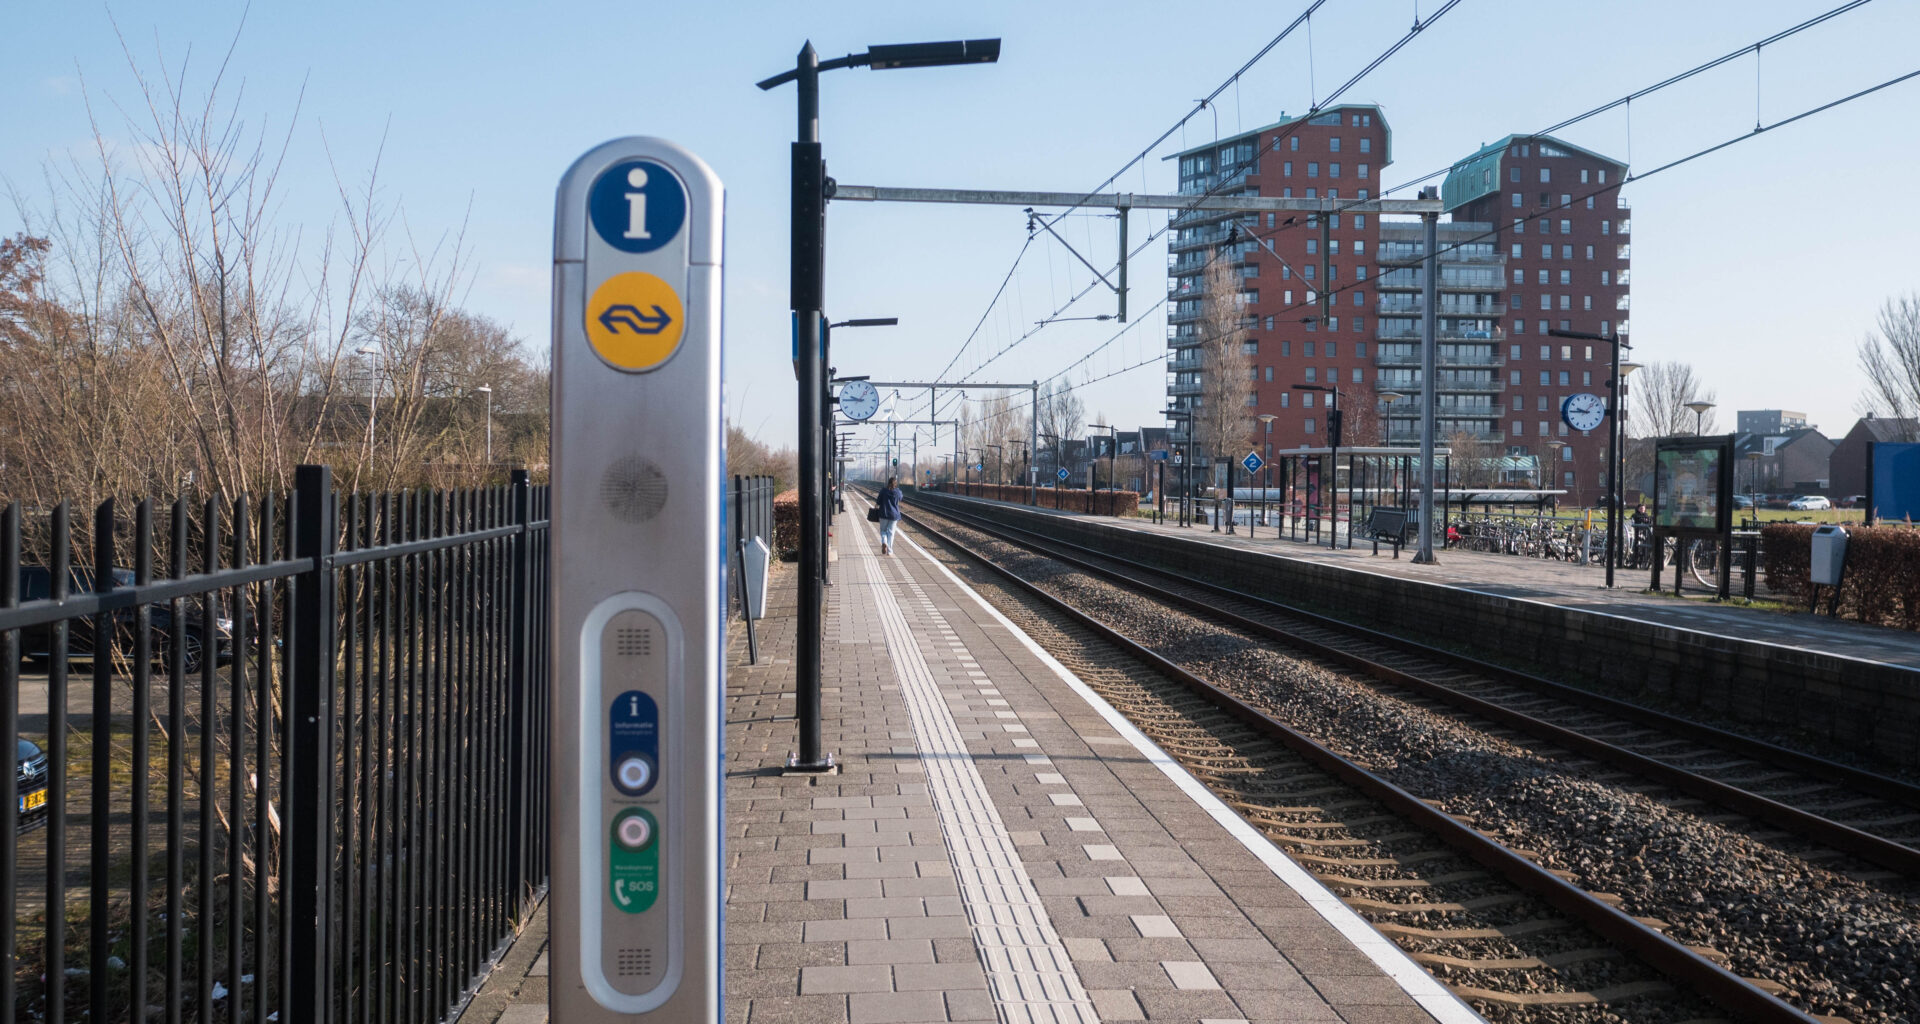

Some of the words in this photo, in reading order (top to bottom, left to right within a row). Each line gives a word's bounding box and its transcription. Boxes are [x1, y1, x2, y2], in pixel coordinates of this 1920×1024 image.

[623, 167, 651, 240] i
[1249, 458, 1257, 468] 2
[629, 881, 654, 892] SOS
